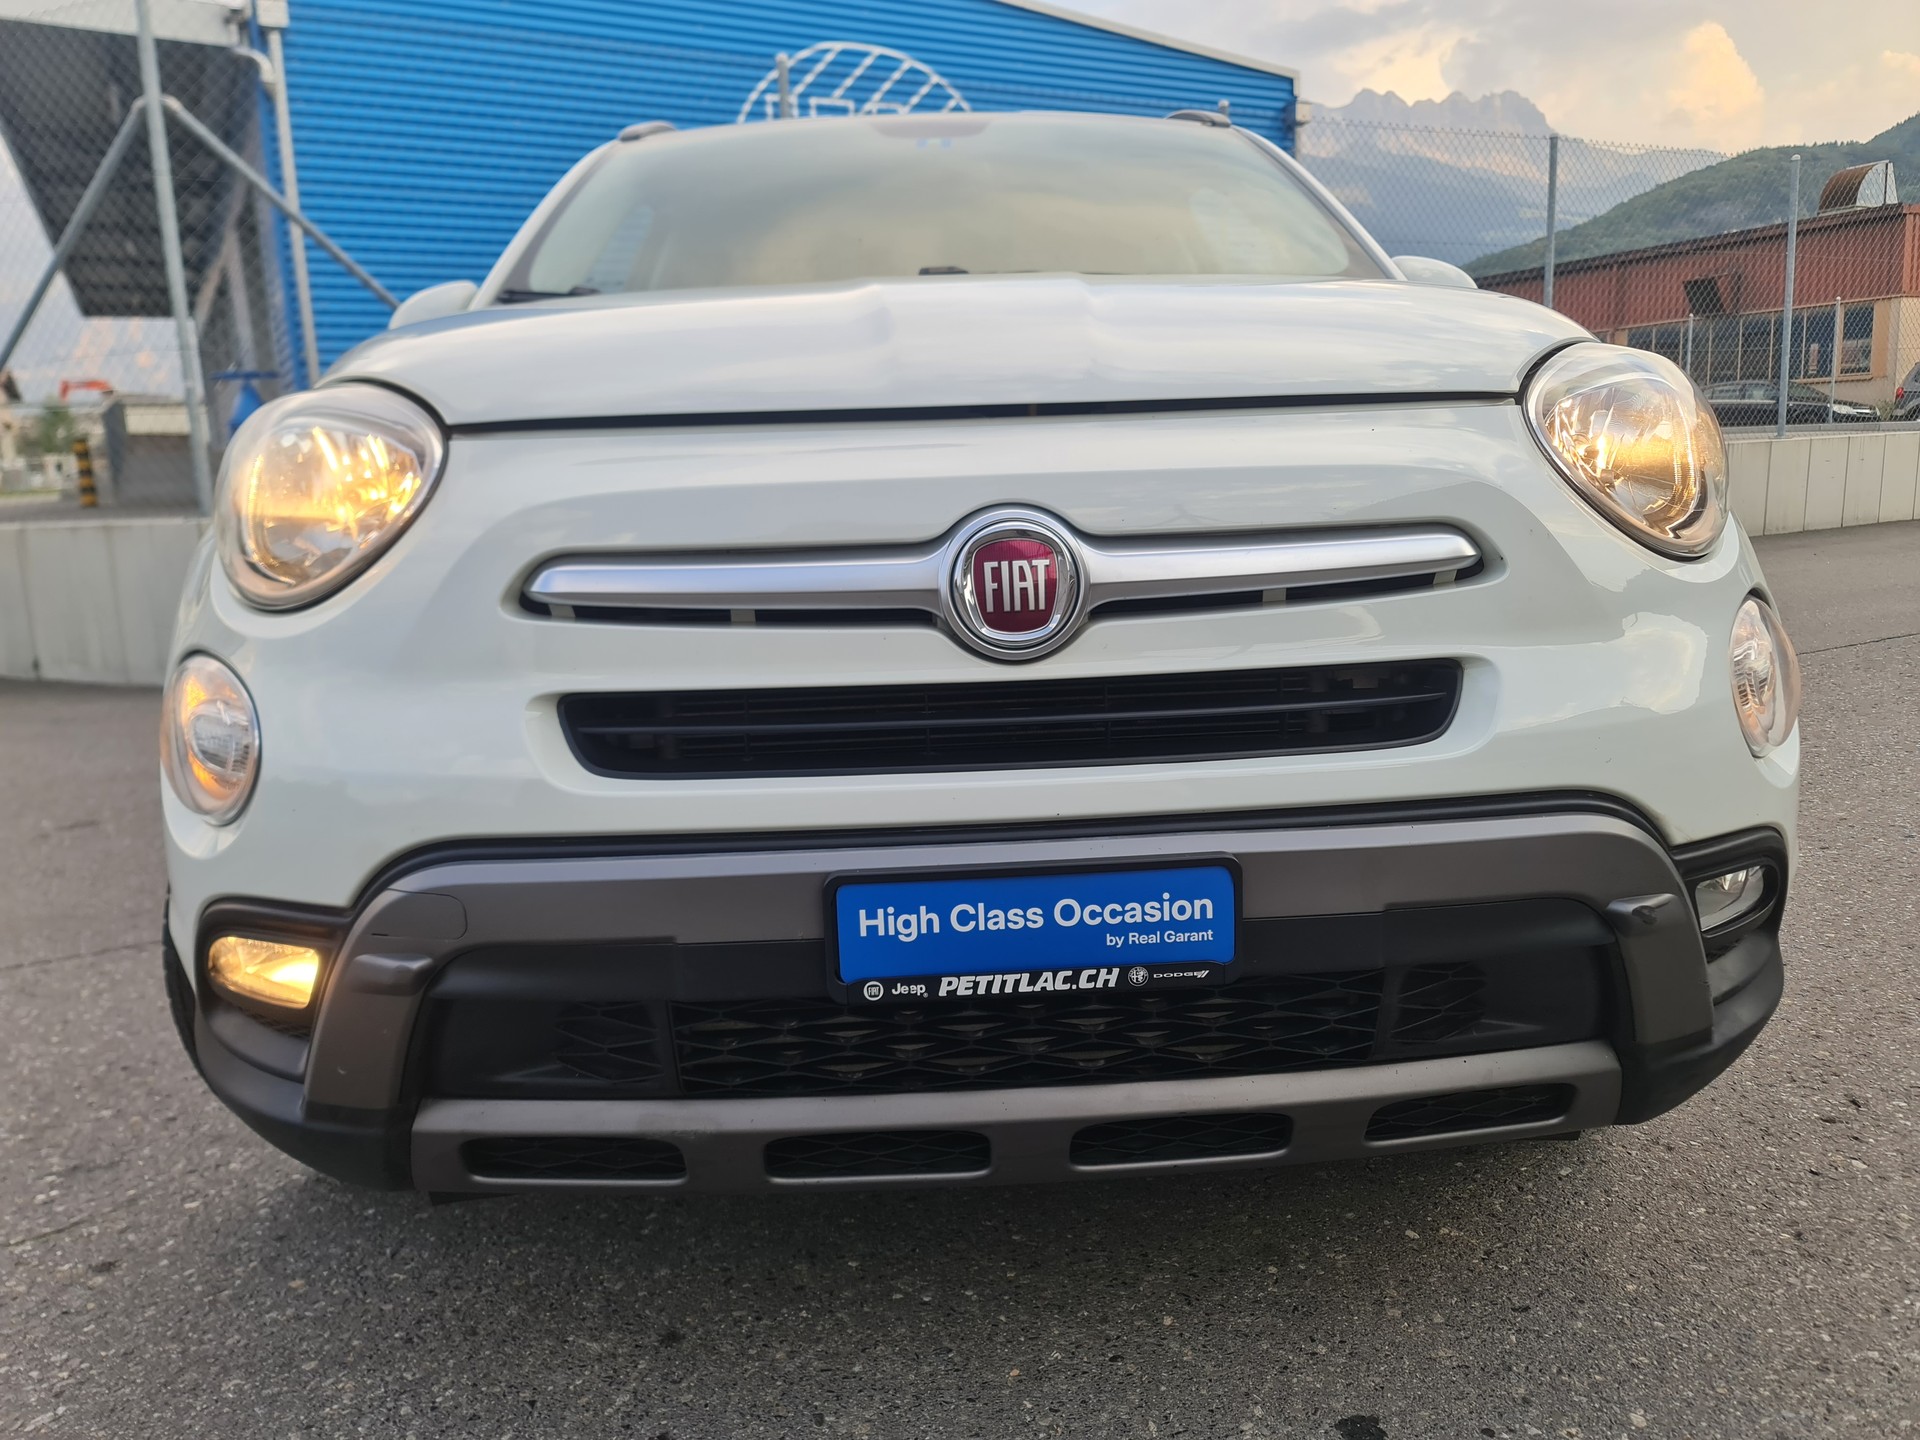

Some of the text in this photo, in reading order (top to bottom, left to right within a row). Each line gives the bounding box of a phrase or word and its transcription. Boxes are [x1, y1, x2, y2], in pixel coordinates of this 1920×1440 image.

[983, 559, 1050, 613] FIAT
[859, 892, 1214, 943] High Class Occasion
[1106, 929, 1214, 949] by Real Garant
[891, 983, 926, 996] Jeep
[938, 967, 1120, 997] PETITLAC.CH
[1153, 971, 1203, 979] DODGE
